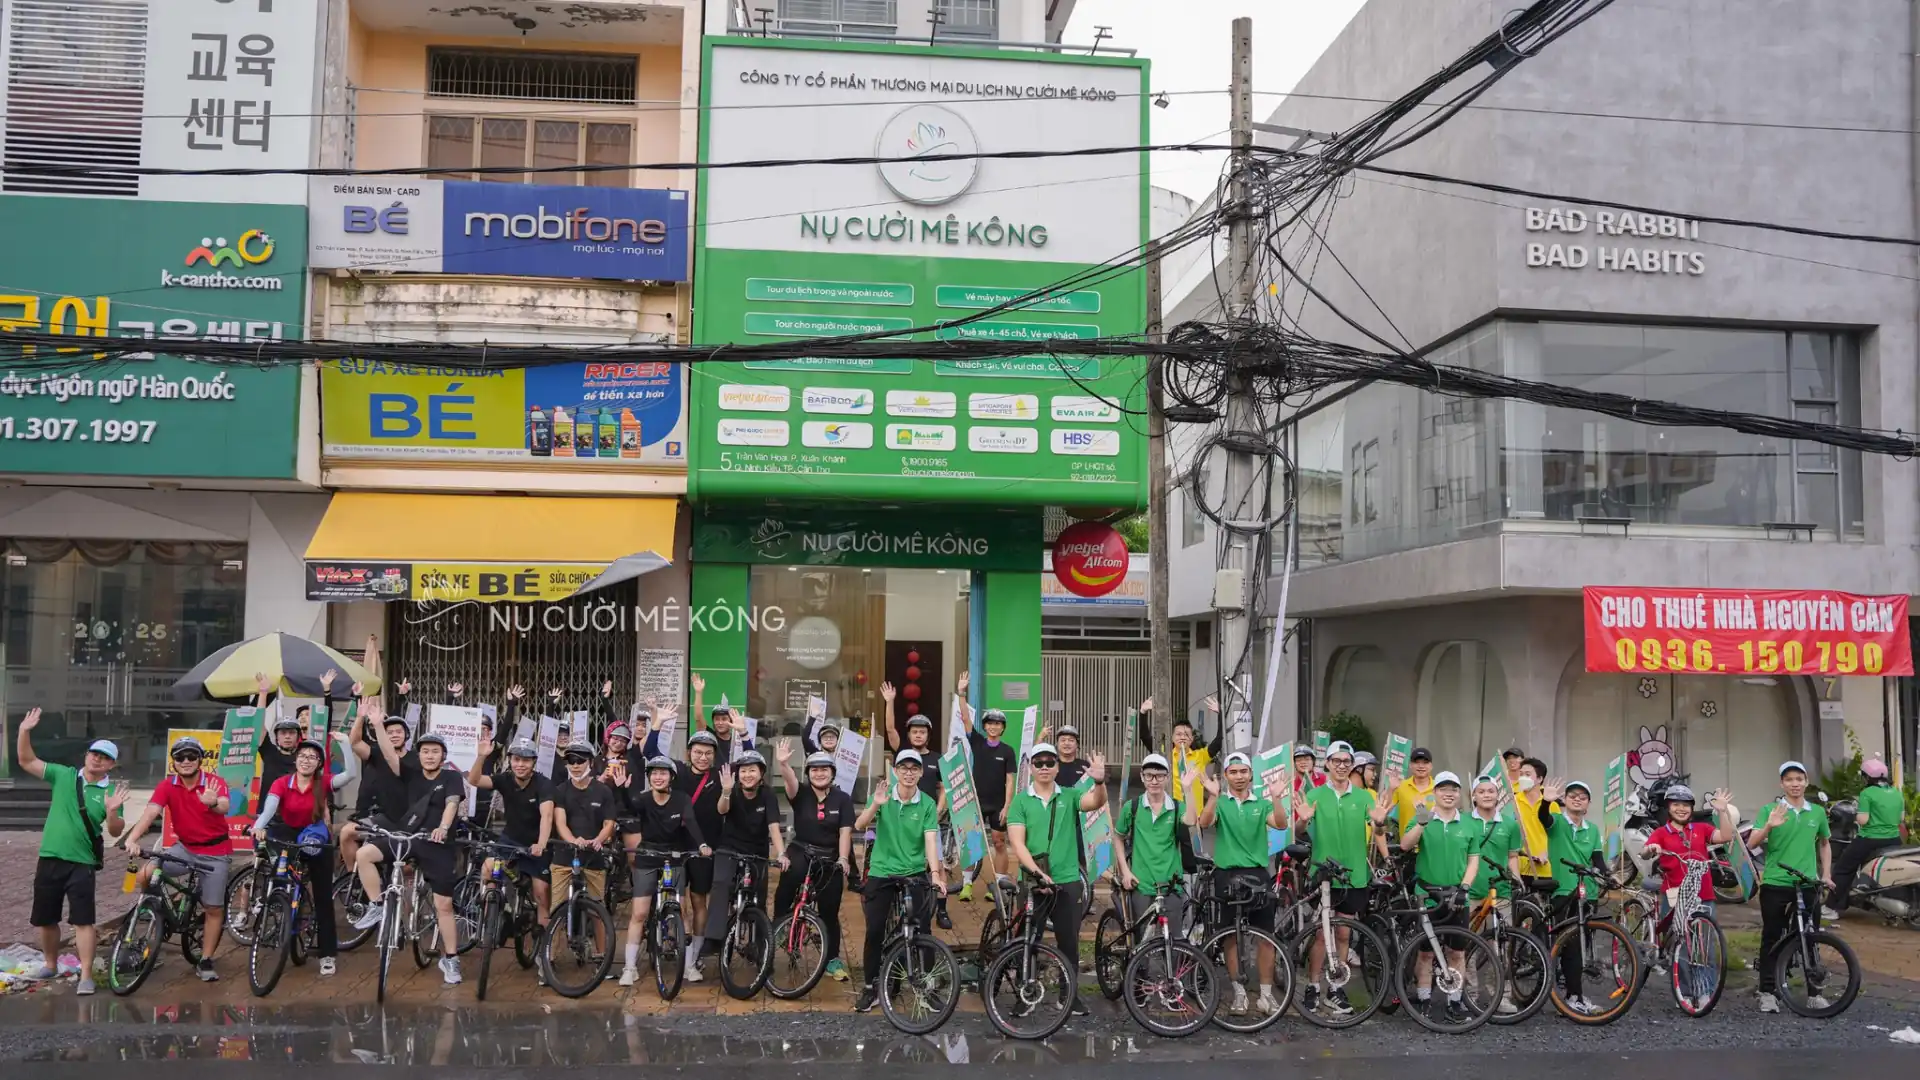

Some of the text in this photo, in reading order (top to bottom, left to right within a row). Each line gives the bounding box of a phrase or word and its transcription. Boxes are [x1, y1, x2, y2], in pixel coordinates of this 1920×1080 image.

[186, 33, 275, 86] 교육
[740, 69, 779, 85] CÔNG
[784, 74, 800, 86] TY
[805, 71, 825, 87] CỔ
[871, 78, 926, 92] THƯƠNG
[931, 80, 953, 95] MẠI
[956, 82, 974, 94] DU
[976, 84, 1003, 98] LỊCH
[1006, 85, 1023, 98] NỤ
[1026, 84, 1057, 98] CƯỜI
[1061, 86, 1077, 100] MÊ
[1081, 88, 1117, 101] KÔNG
[183, 98, 271, 152] 센터
[376, 187, 391, 195] SIM
[397, 187, 420, 196] CARD
[344, 201, 409, 235] BÉ
[464, 205, 667, 244] mobifone
[801, 211, 1048, 247] NỤ CƯỜI MÊ KÔNG
[1525, 207, 1700, 240] BAD RABBIT
[573, 244, 595, 253] mọi
[597, 243, 615, 254] lúc
[1526, 243, 1706, 276] BAD HABITS
[161, 269, 282, 290] k-cantho.com
[766, 285, 783, 293] Tour
[797, 286, 812, 296] lịch
[814, 287, 836, 297] trong
[775, 320, 793, 328] Tour
[794, 321, 810, 329] cho
[583, 363, 671, 380] RACER
[40, 372, 94, 403] Ngôn
[97, 374, 139, 403] ngữ
[140, 374, 179, 399] Hàn
[181, 371, 235, 400] Quốc
[628, 391, 643, 399] xa
[369, 382, 477, 439] BÉ
[807, 396, 852, 405] BAMBOO
[1063, 433, 1092, 445] HBS
[720, 452, 732, 471] 5
[803, 530, 989, 556] NỤ CƯỜI MÊ KÔNG
[420, 568, 470, 589] SỬA XE
[479, 568, 541, 596] BÉ
[550, 570, 566, 584] SỬA
[1601, 593, 1894, 633] CHO THUÊ NHÀ NGUYÊN CĂN
[1616, 638, 1883, 673] 0936. 150 790
[1823, 677, 1836, 699] 7
